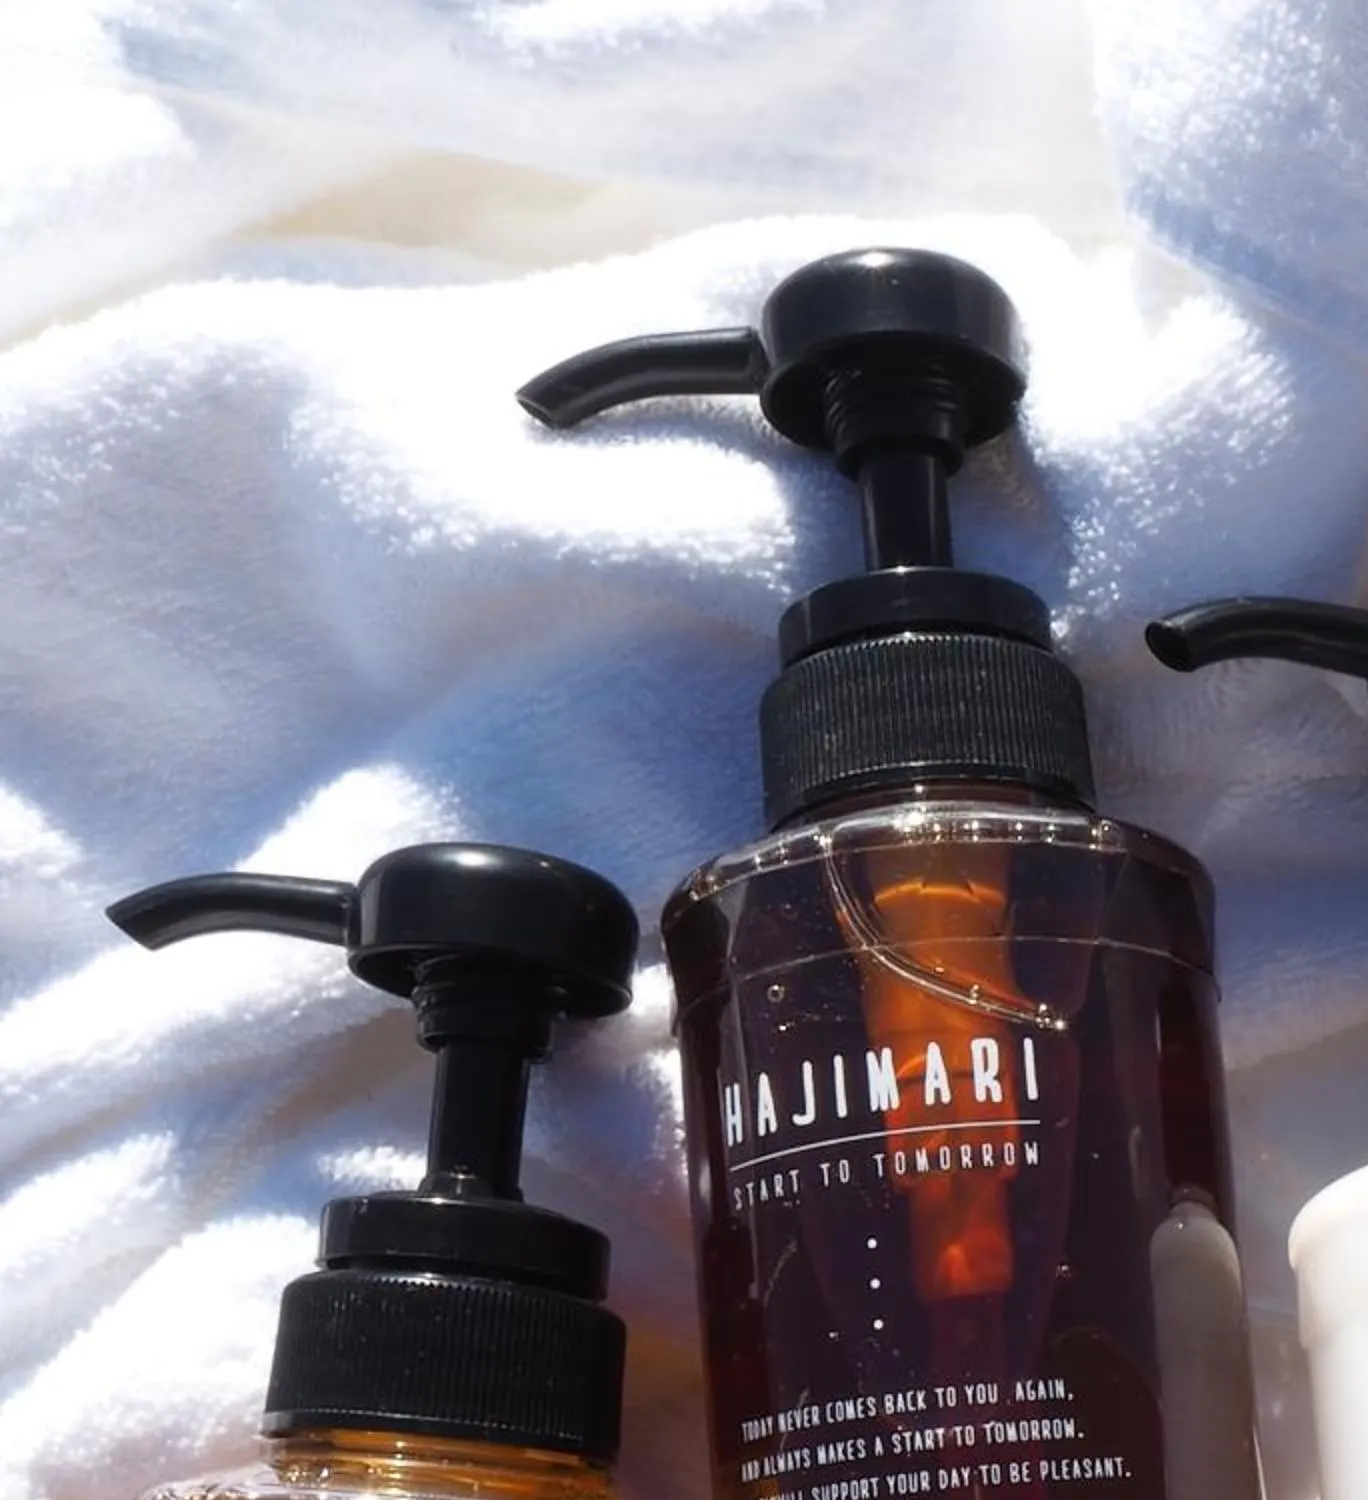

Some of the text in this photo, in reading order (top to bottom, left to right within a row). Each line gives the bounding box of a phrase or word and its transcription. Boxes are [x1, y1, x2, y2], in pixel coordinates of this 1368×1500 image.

[724, 1037, 1039, 1148] HAJIMARI
[734, 1142, 1039, 1211] START TO TOMORROW
[741, 1416, 774, 1443] TODAY
[777, 1405, 820, 1433] NEVER
[826, 1396, 877, 1423] COMES
[884, 1390, 927, 1414] BACK
[935, 1386, 956, 1408] TO
[965, 1383, 998, 1406] YOU
[741, 1417, 1085, 1483] AND ALWAYS MAKES A START TO TOMORROW.
[886, 1470, 931, 1495] YOUR
[938, 1466, 970, 1490] DAY
[979, 1463, 1001, 1485] TO
[1009, 1461, 1031, 1483] BE
[1039, 1457, 1132, 1481] PLEASANT.
